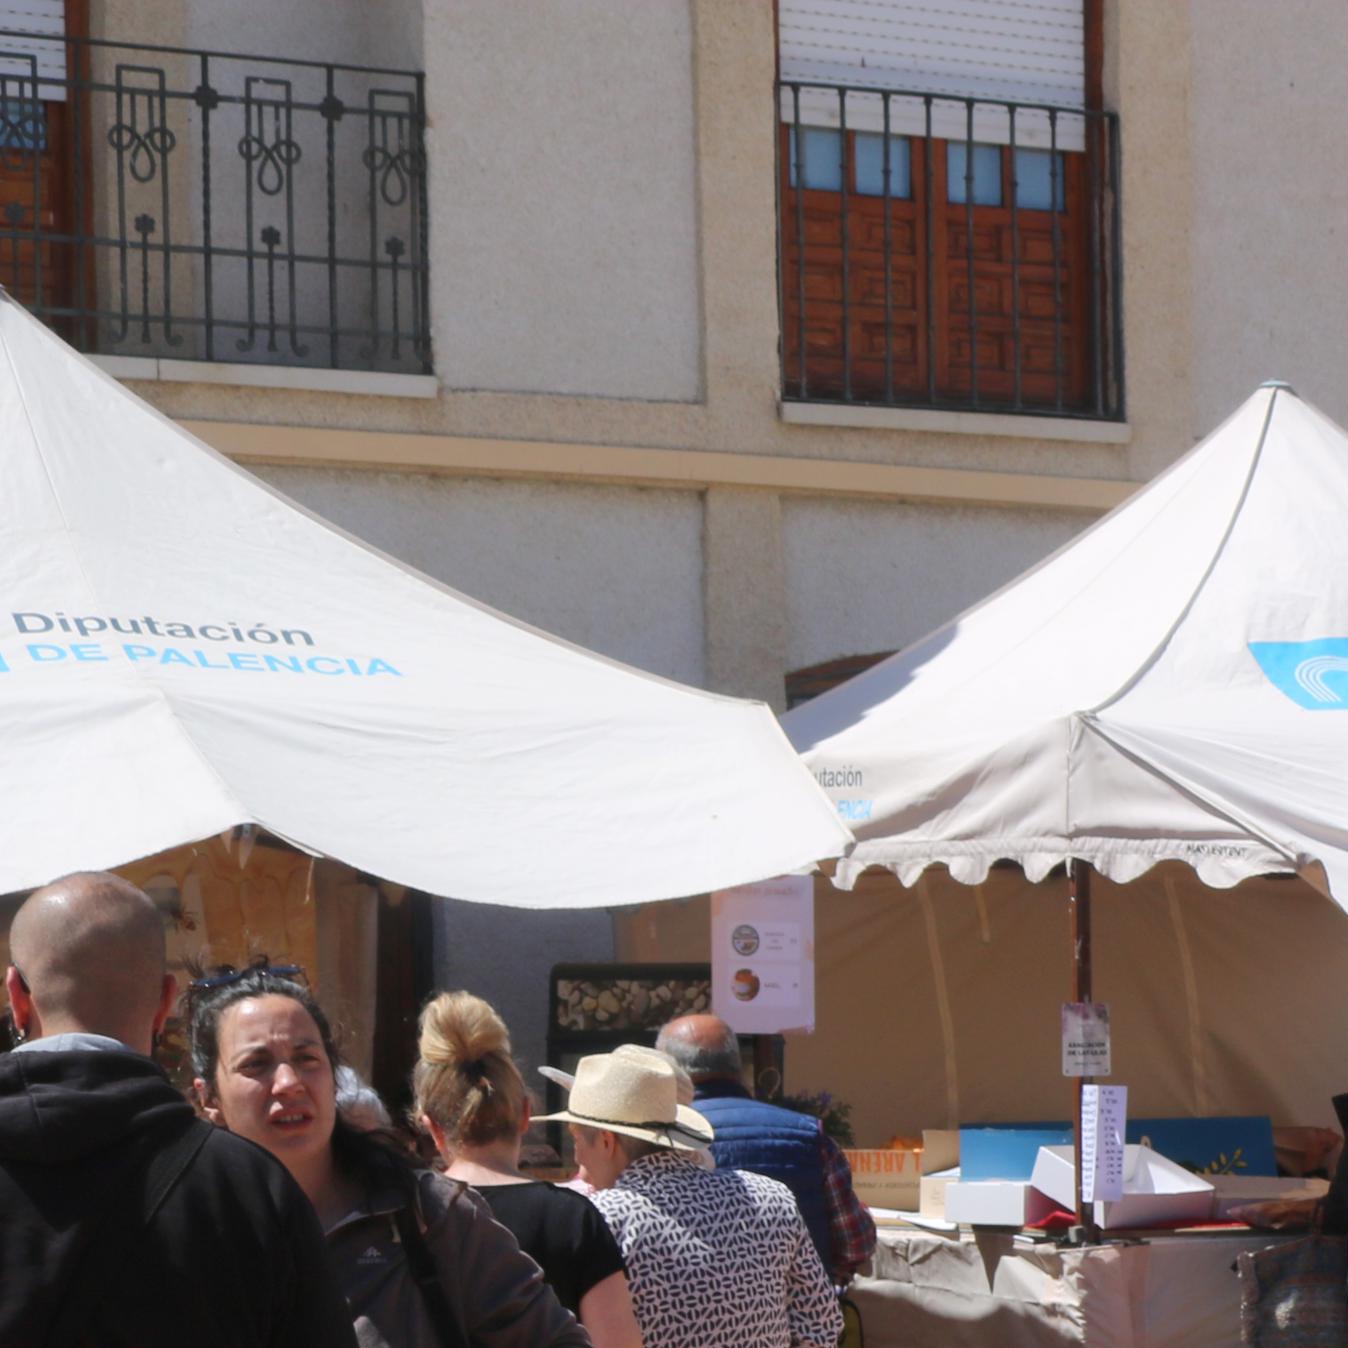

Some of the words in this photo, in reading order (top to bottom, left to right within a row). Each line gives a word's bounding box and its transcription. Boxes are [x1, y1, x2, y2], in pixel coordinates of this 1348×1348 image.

[11, 612, 316, 646] Diputación
[26, 643, 109, 662] DE
[121, 643, 404, 677] PALENCIA
[814, 764, 863, 788] utación
[846, 1152, 905, 1174] ARENA
